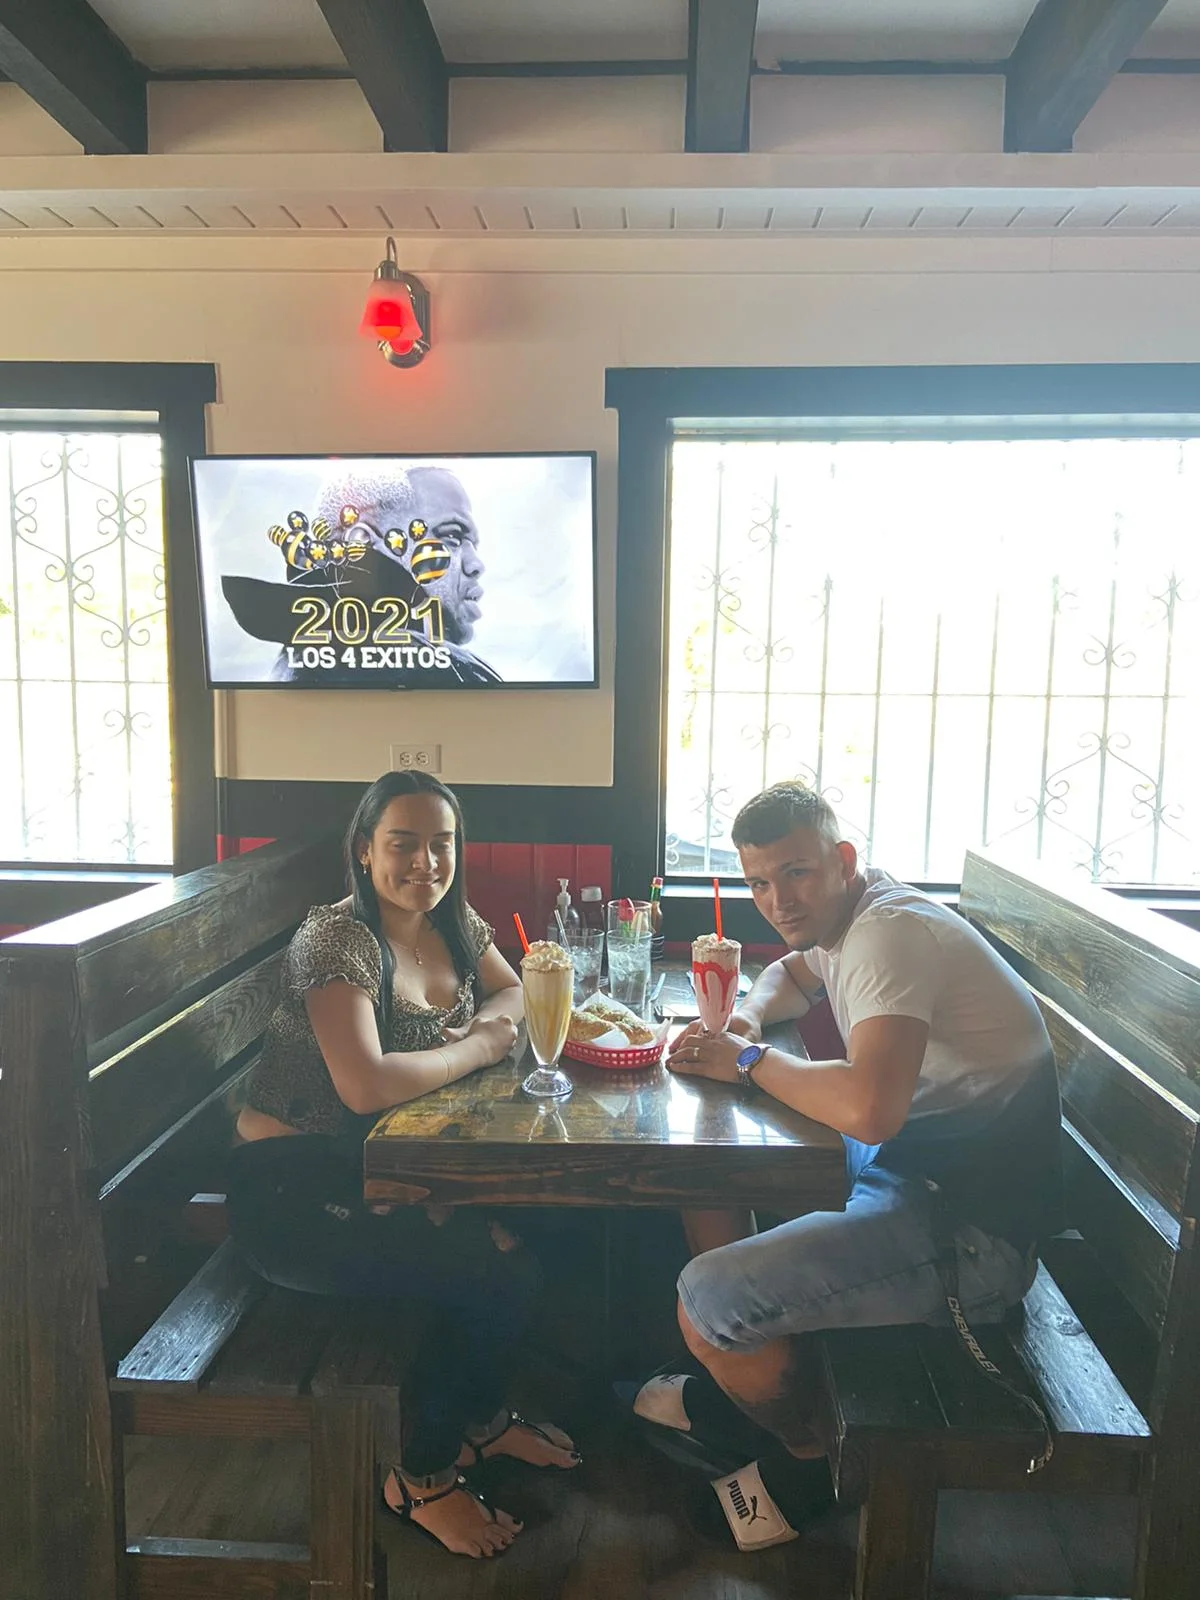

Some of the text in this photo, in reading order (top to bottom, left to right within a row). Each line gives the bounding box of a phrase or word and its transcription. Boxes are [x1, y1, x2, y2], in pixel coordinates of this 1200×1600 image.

[291, 597, 445, 645] 2021
[286, 646, 451, 669] LOS 4 EXITOS
[947, 1296, 1001, 1374] CHEVROLET
[727, 1479, 750, 1520] PUMA
